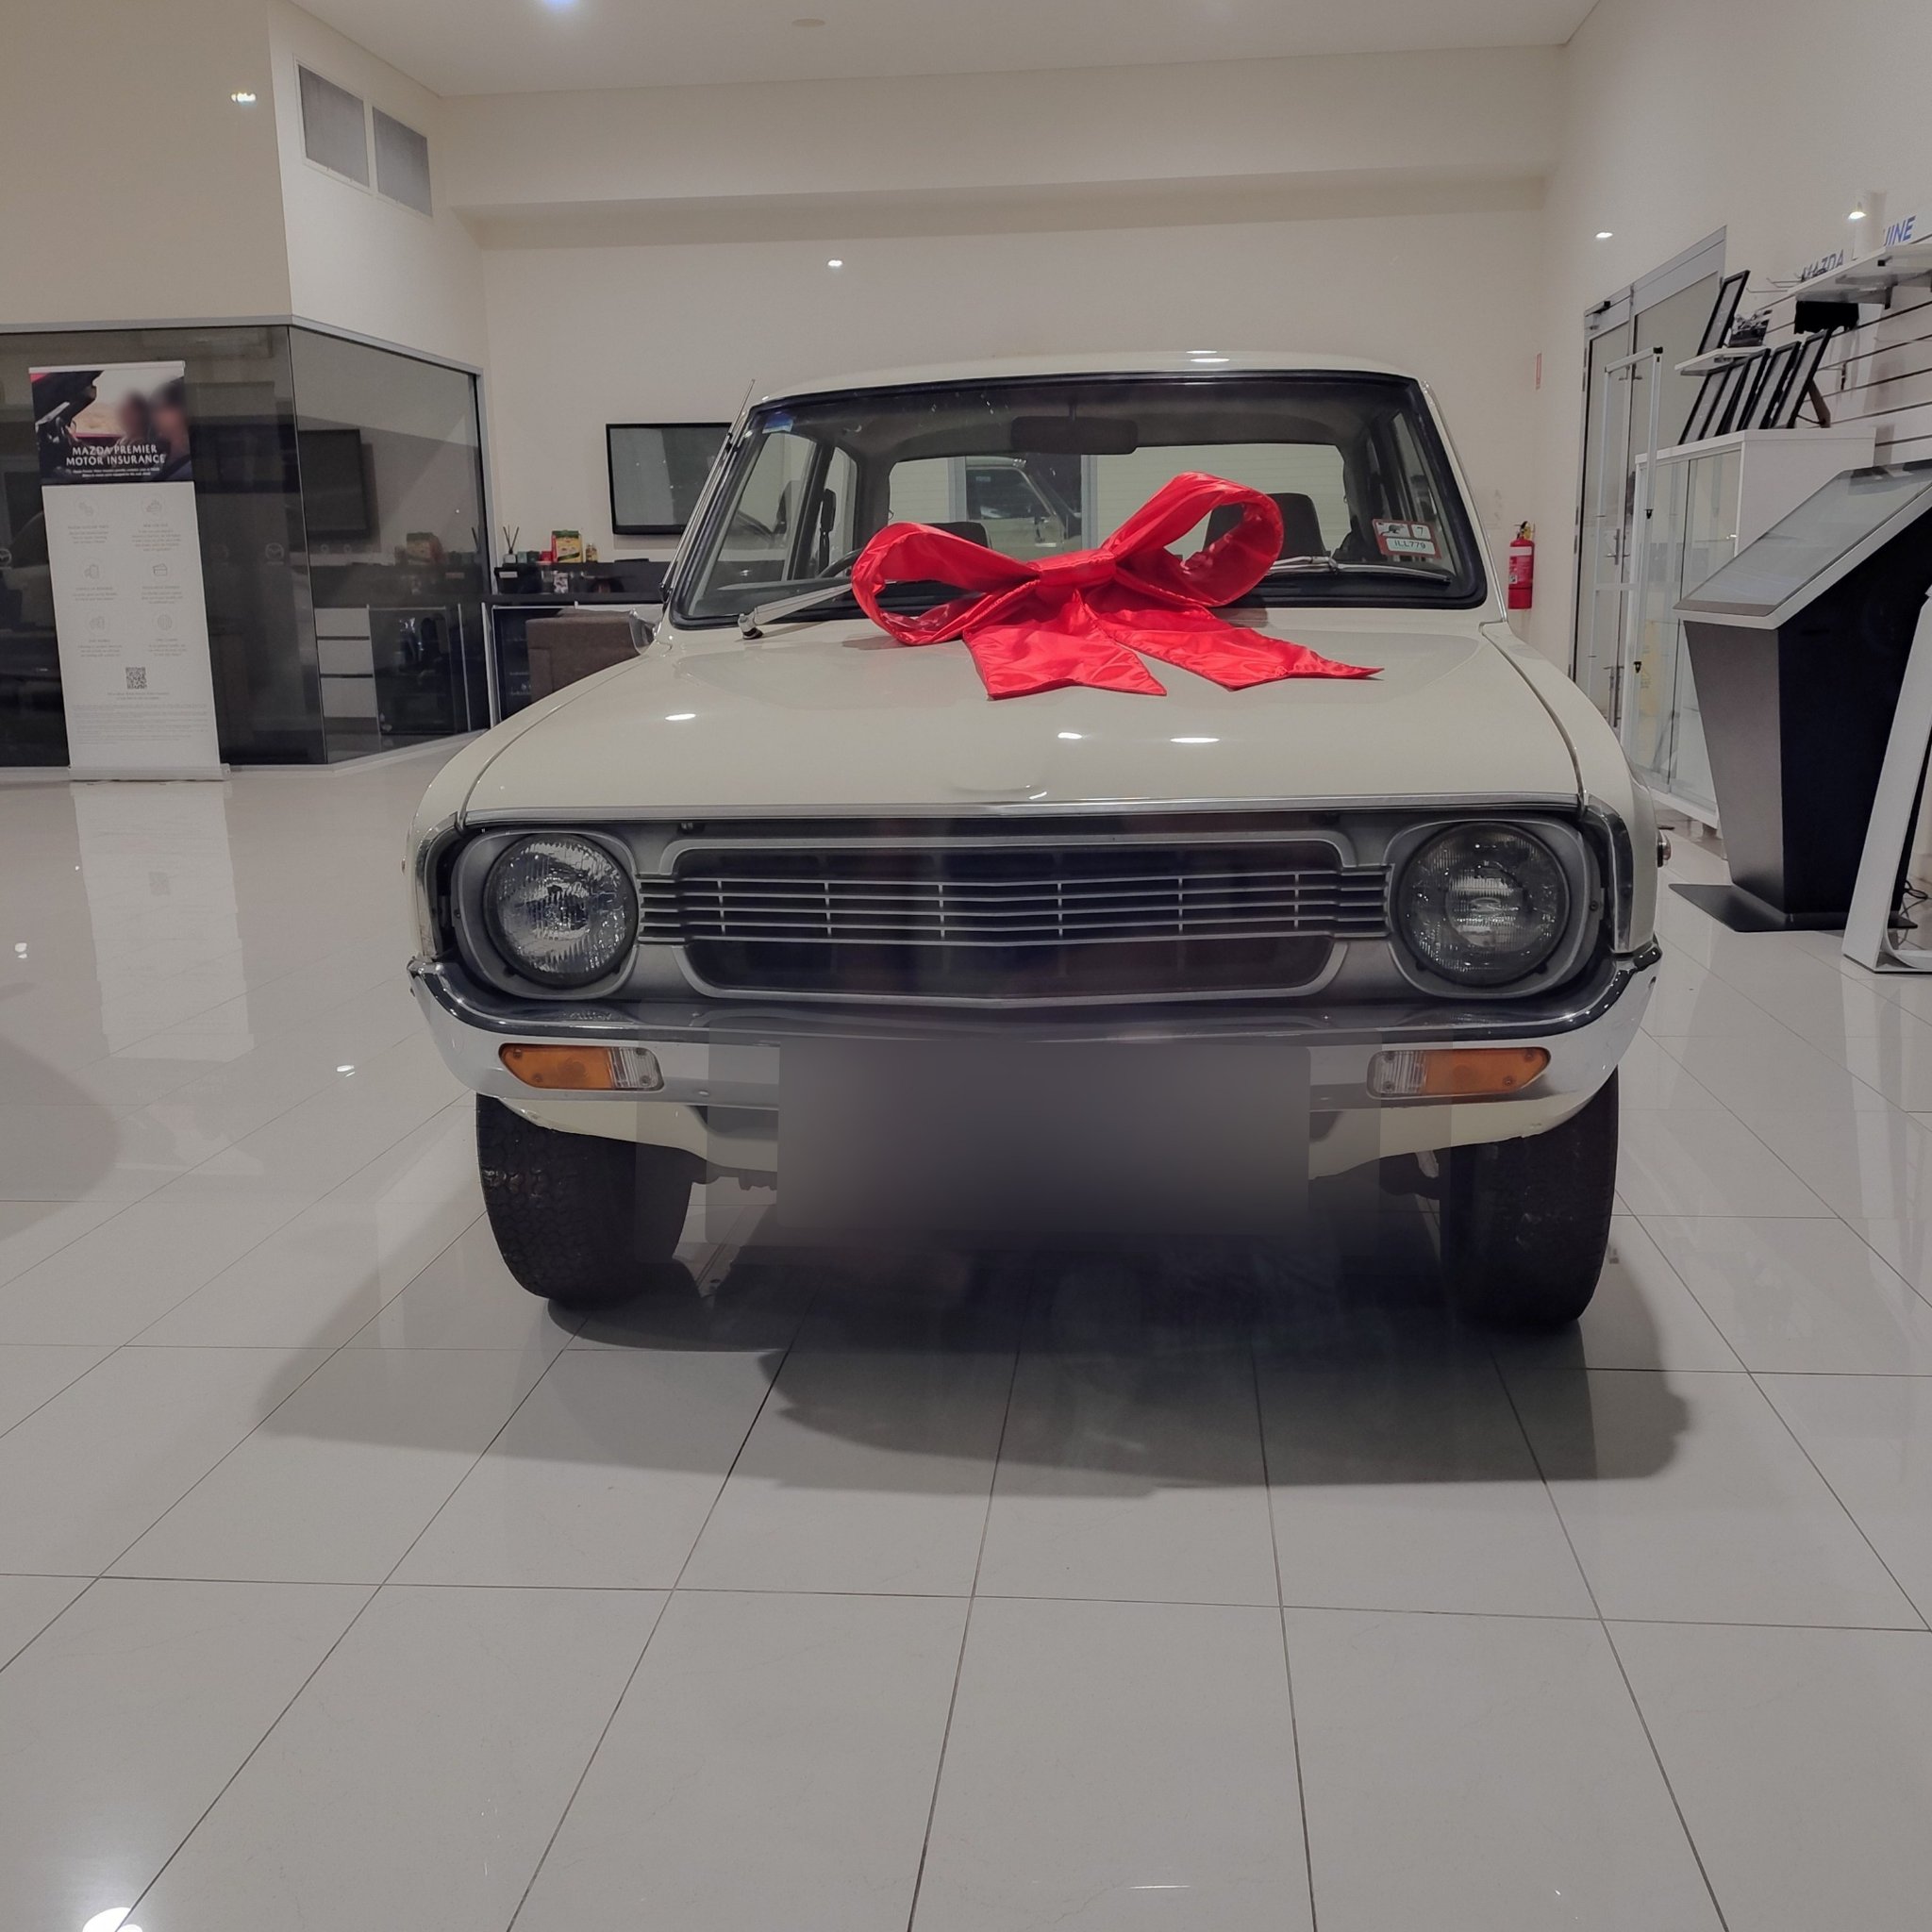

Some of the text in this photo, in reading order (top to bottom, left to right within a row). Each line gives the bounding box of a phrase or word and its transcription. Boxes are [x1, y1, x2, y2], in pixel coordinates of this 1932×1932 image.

[72, 444, 158, 456] MAZDA PREMIER
[66, 454, 166, 466] MOTOR INSURANCE
[1416, 525, 1424, 537] 7
